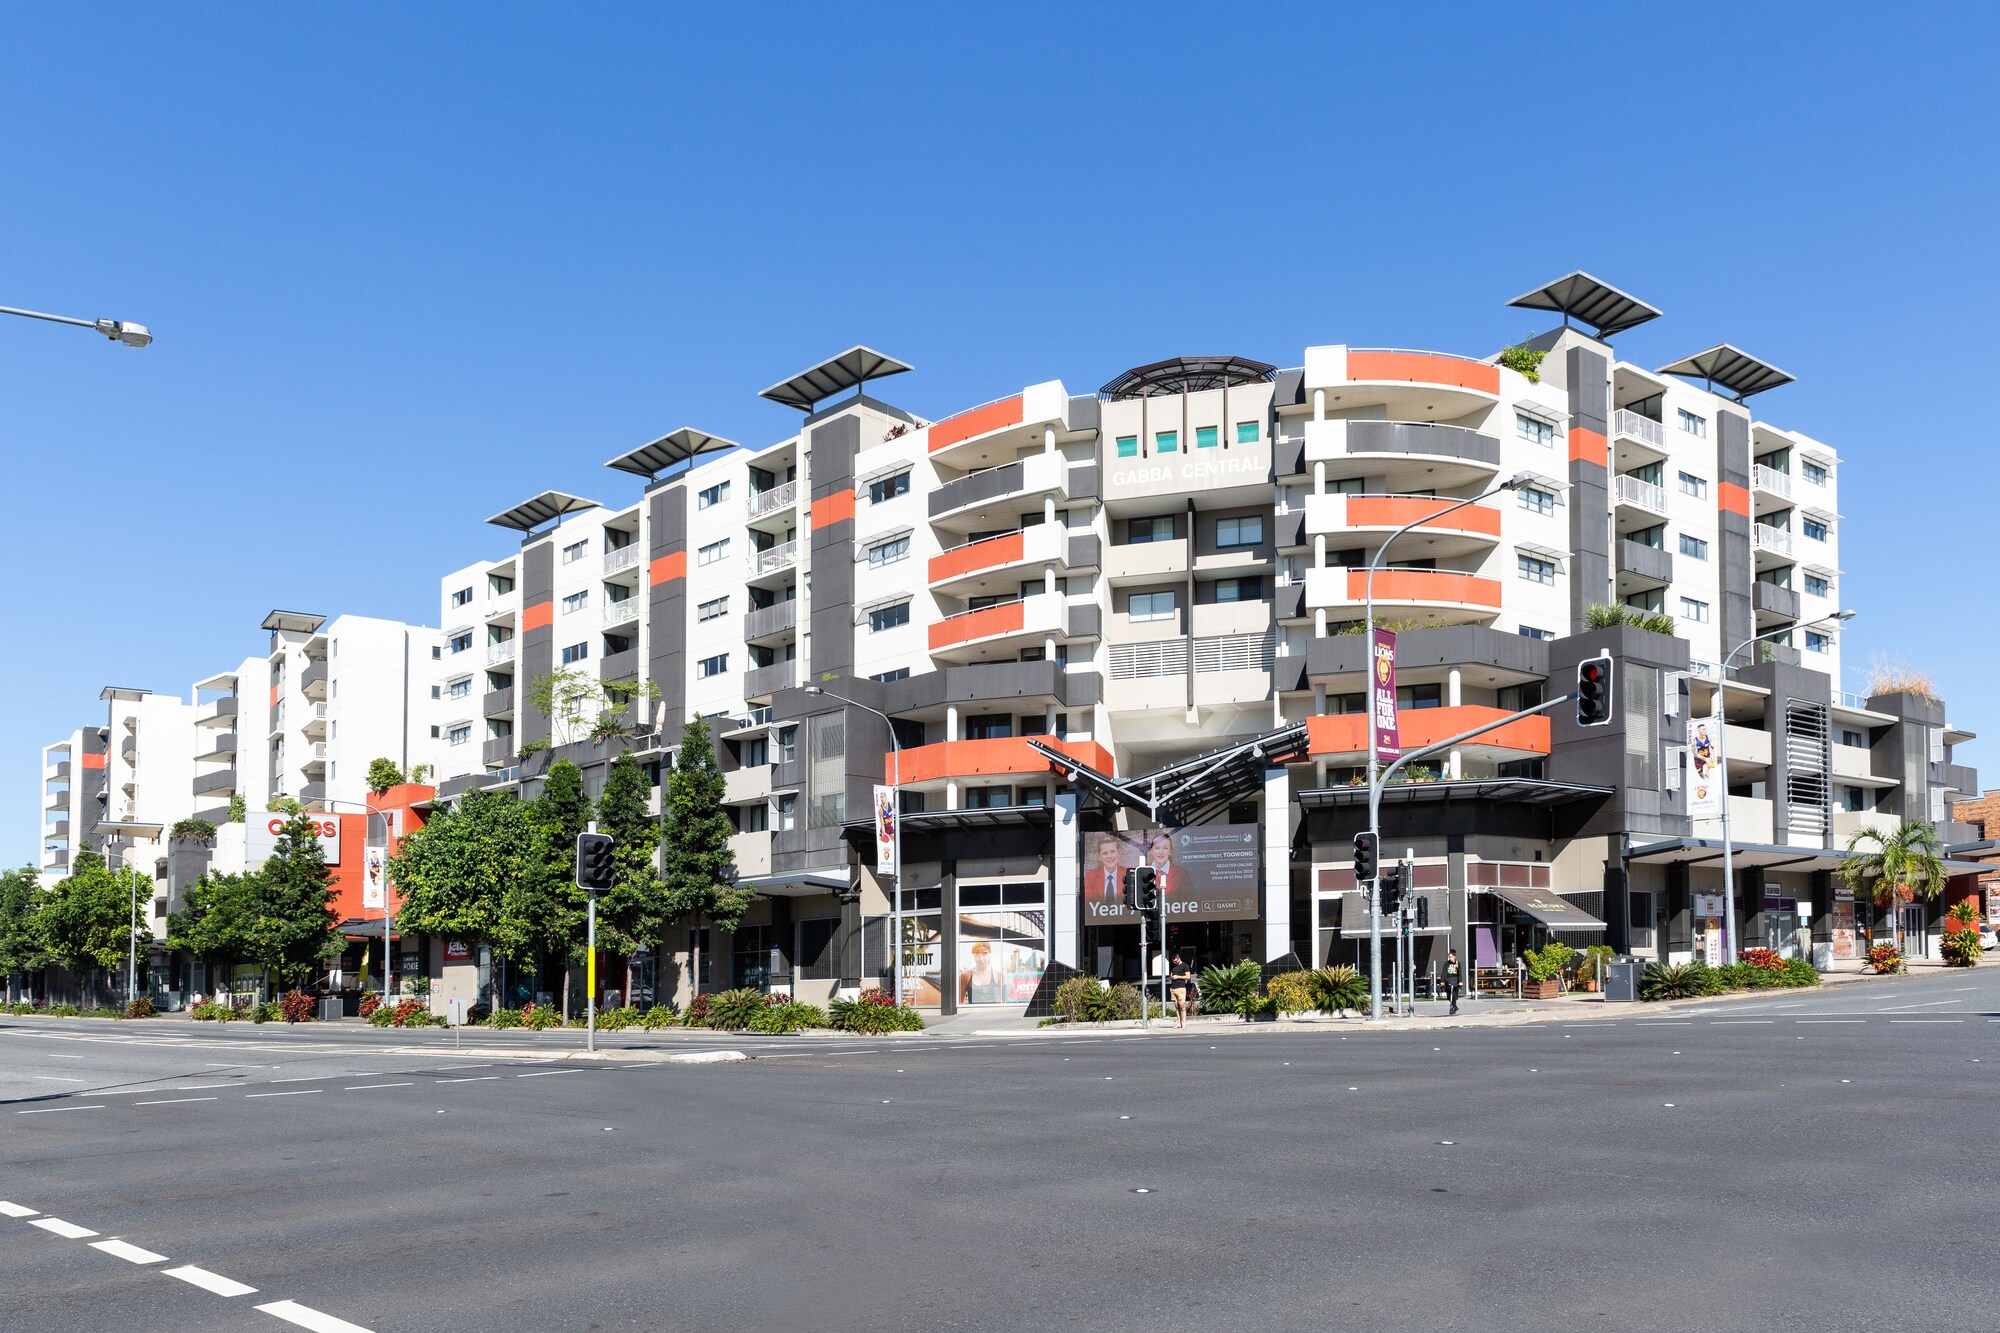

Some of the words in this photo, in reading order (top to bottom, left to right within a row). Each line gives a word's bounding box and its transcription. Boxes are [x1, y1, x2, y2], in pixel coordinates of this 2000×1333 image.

[1112, 465, 1173, 486] GABBA
[1181, 455, 1264, 479] CENTRAL
[1375, 645, 1394, 661] LIONS
[1376, 688, 1394, 704] ALL
[1376, 701, 1395, 718] FOR
[1376, 714, 1397, 730] ONE
[267, 818, 337, 837] ces
[1089, 901, 1125, 917] Year
